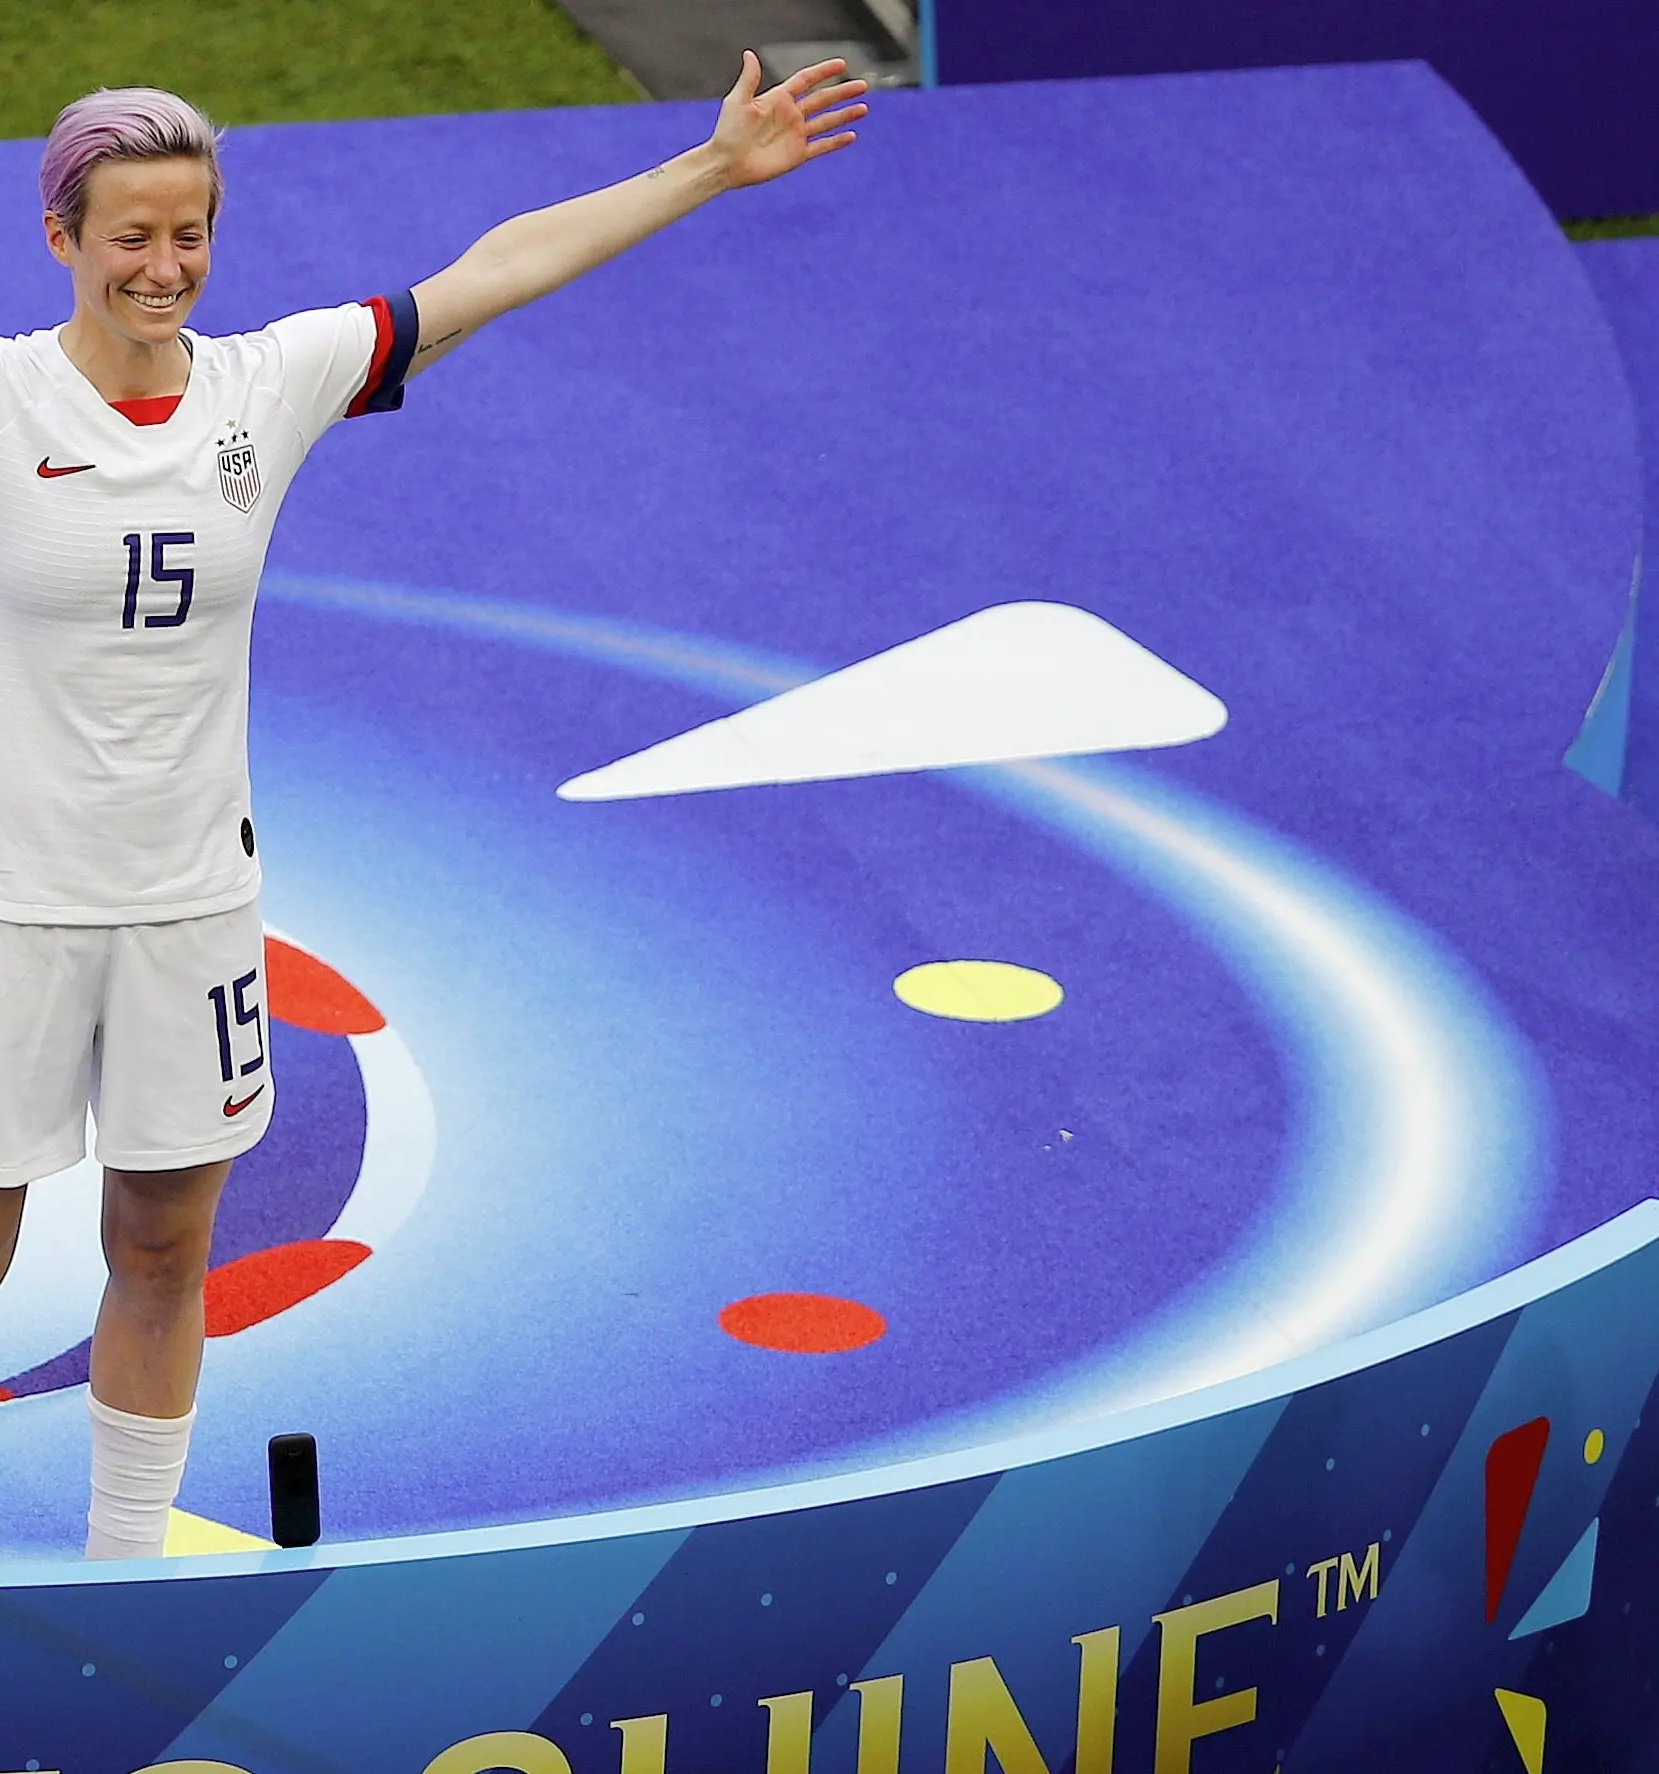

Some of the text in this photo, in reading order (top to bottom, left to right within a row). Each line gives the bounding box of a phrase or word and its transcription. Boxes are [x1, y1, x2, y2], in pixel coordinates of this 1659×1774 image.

[221, 450, 252, 476] USA
[123, 532, 195, 628] 15
[207, 967, 264, 1082] 15
